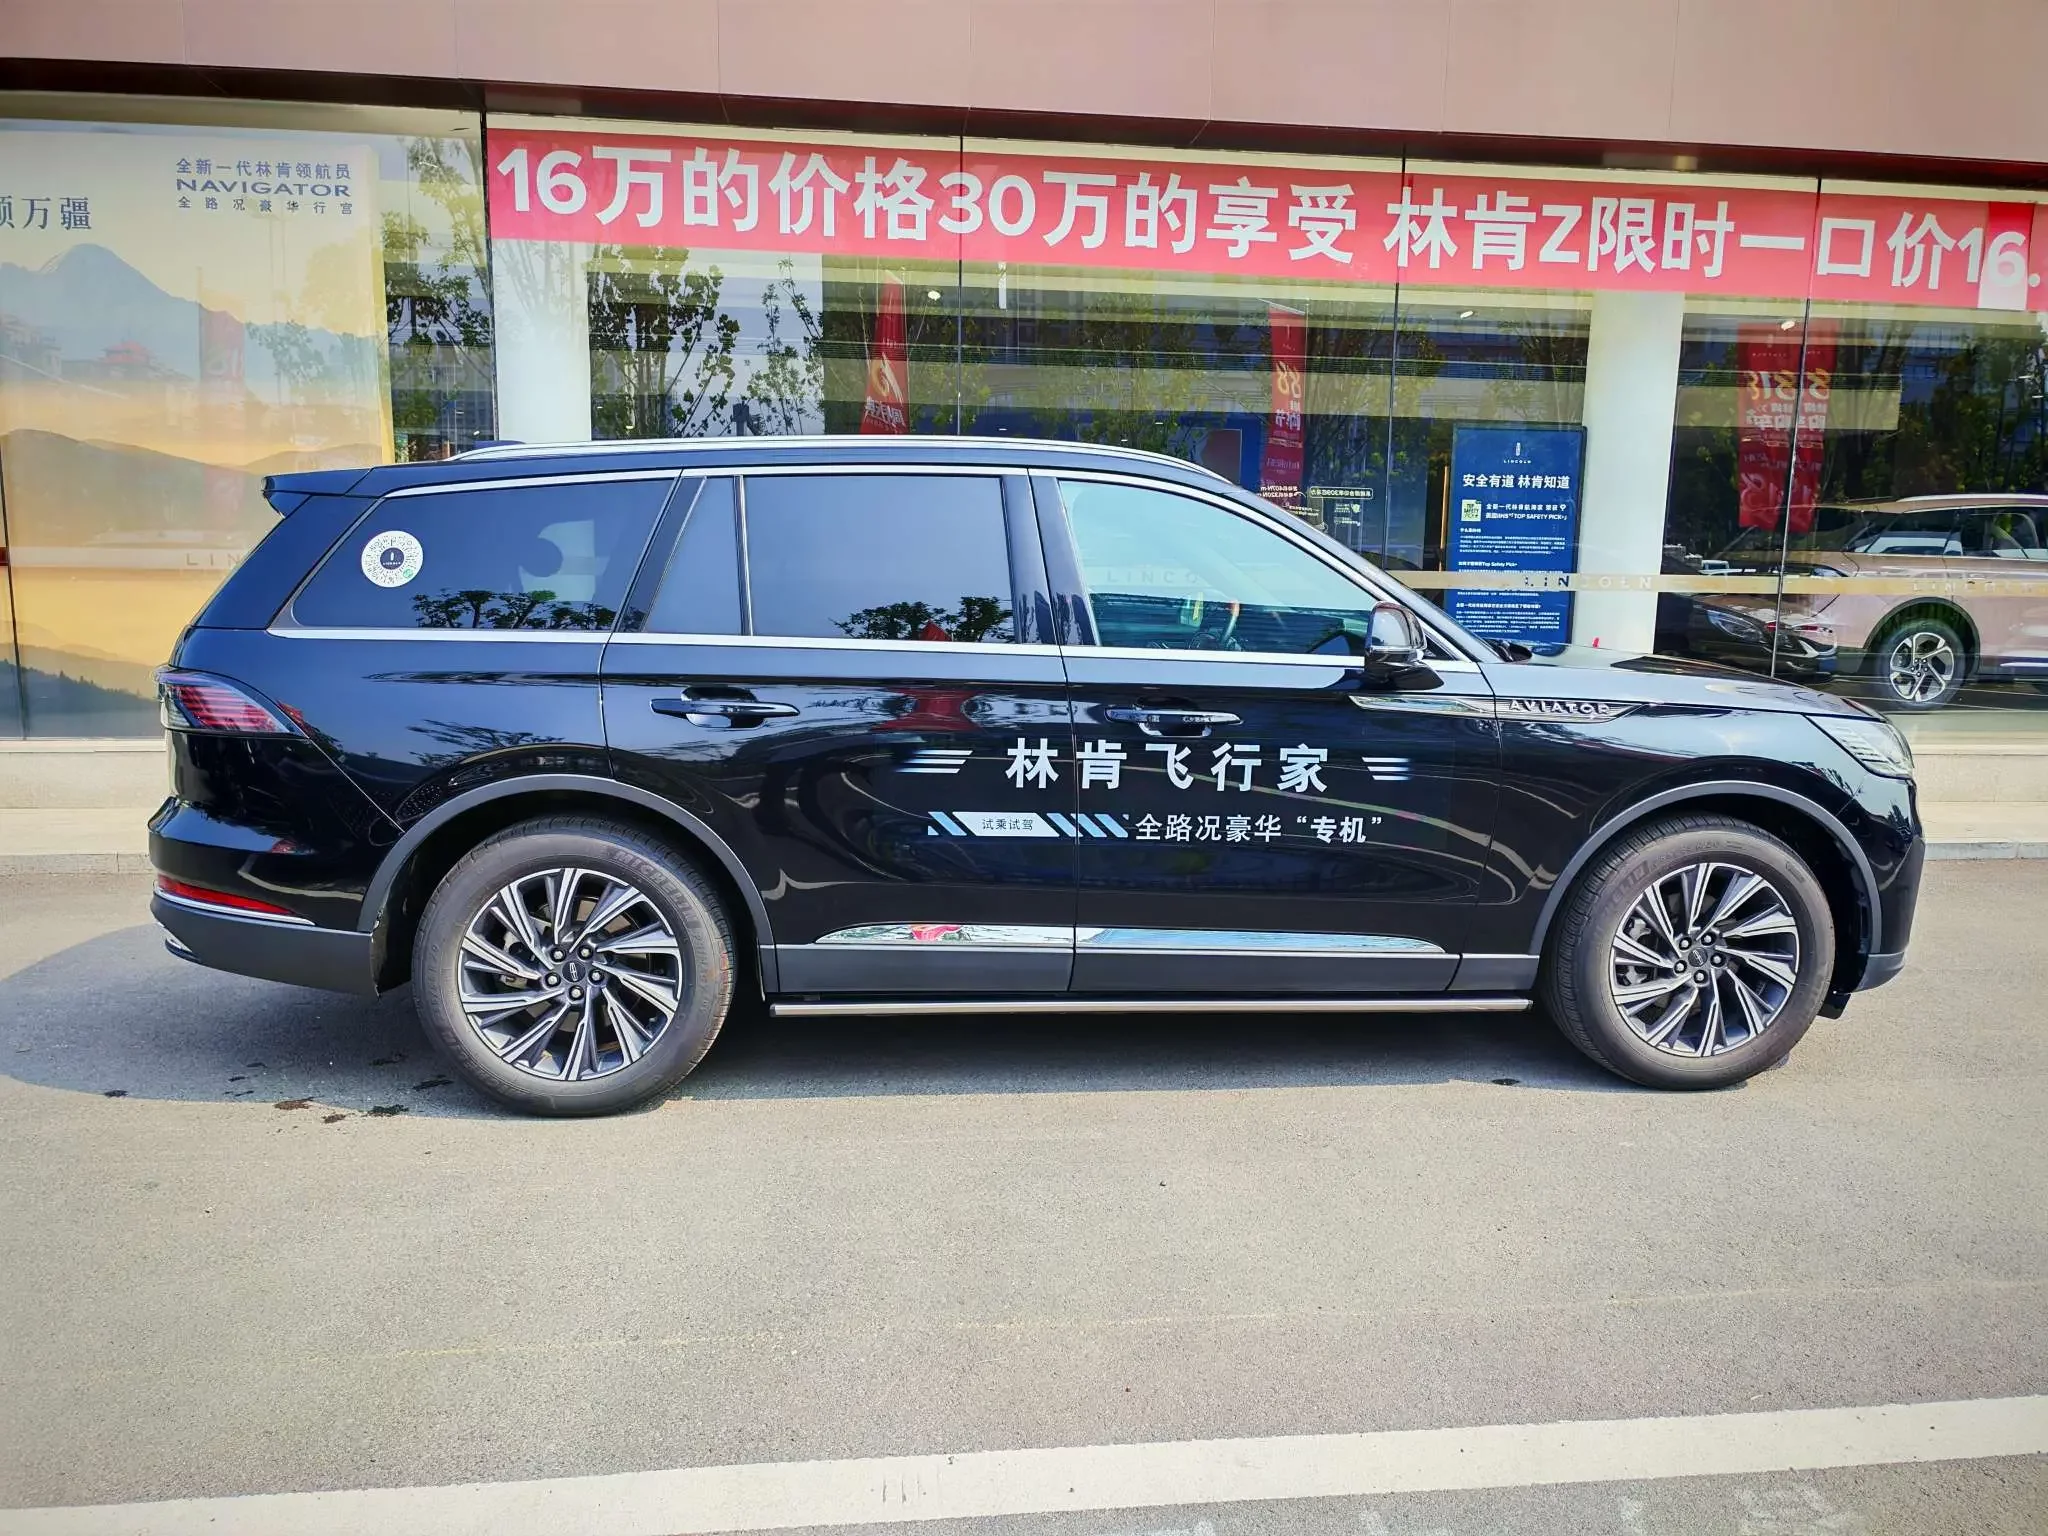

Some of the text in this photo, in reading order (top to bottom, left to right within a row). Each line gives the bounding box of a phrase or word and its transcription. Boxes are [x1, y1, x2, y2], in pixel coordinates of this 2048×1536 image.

[175, 158, 351, 181] 全新一代林肯领航员
[175, 178, 351, 198] NAVIGATOR
[177, 196, 353, 216] 全路况豪华行宫
[496, 145, 1358, 266] 16万的价格30万的享受
[1462, 474, 1570, 490] 安全有道 林肯知道
[1509, 699, 1611, 715] AVIATOR
[1005, 737, 1331, 793] 林肯飞行家
[982, 817, 1034, 831] 试乘试驾
